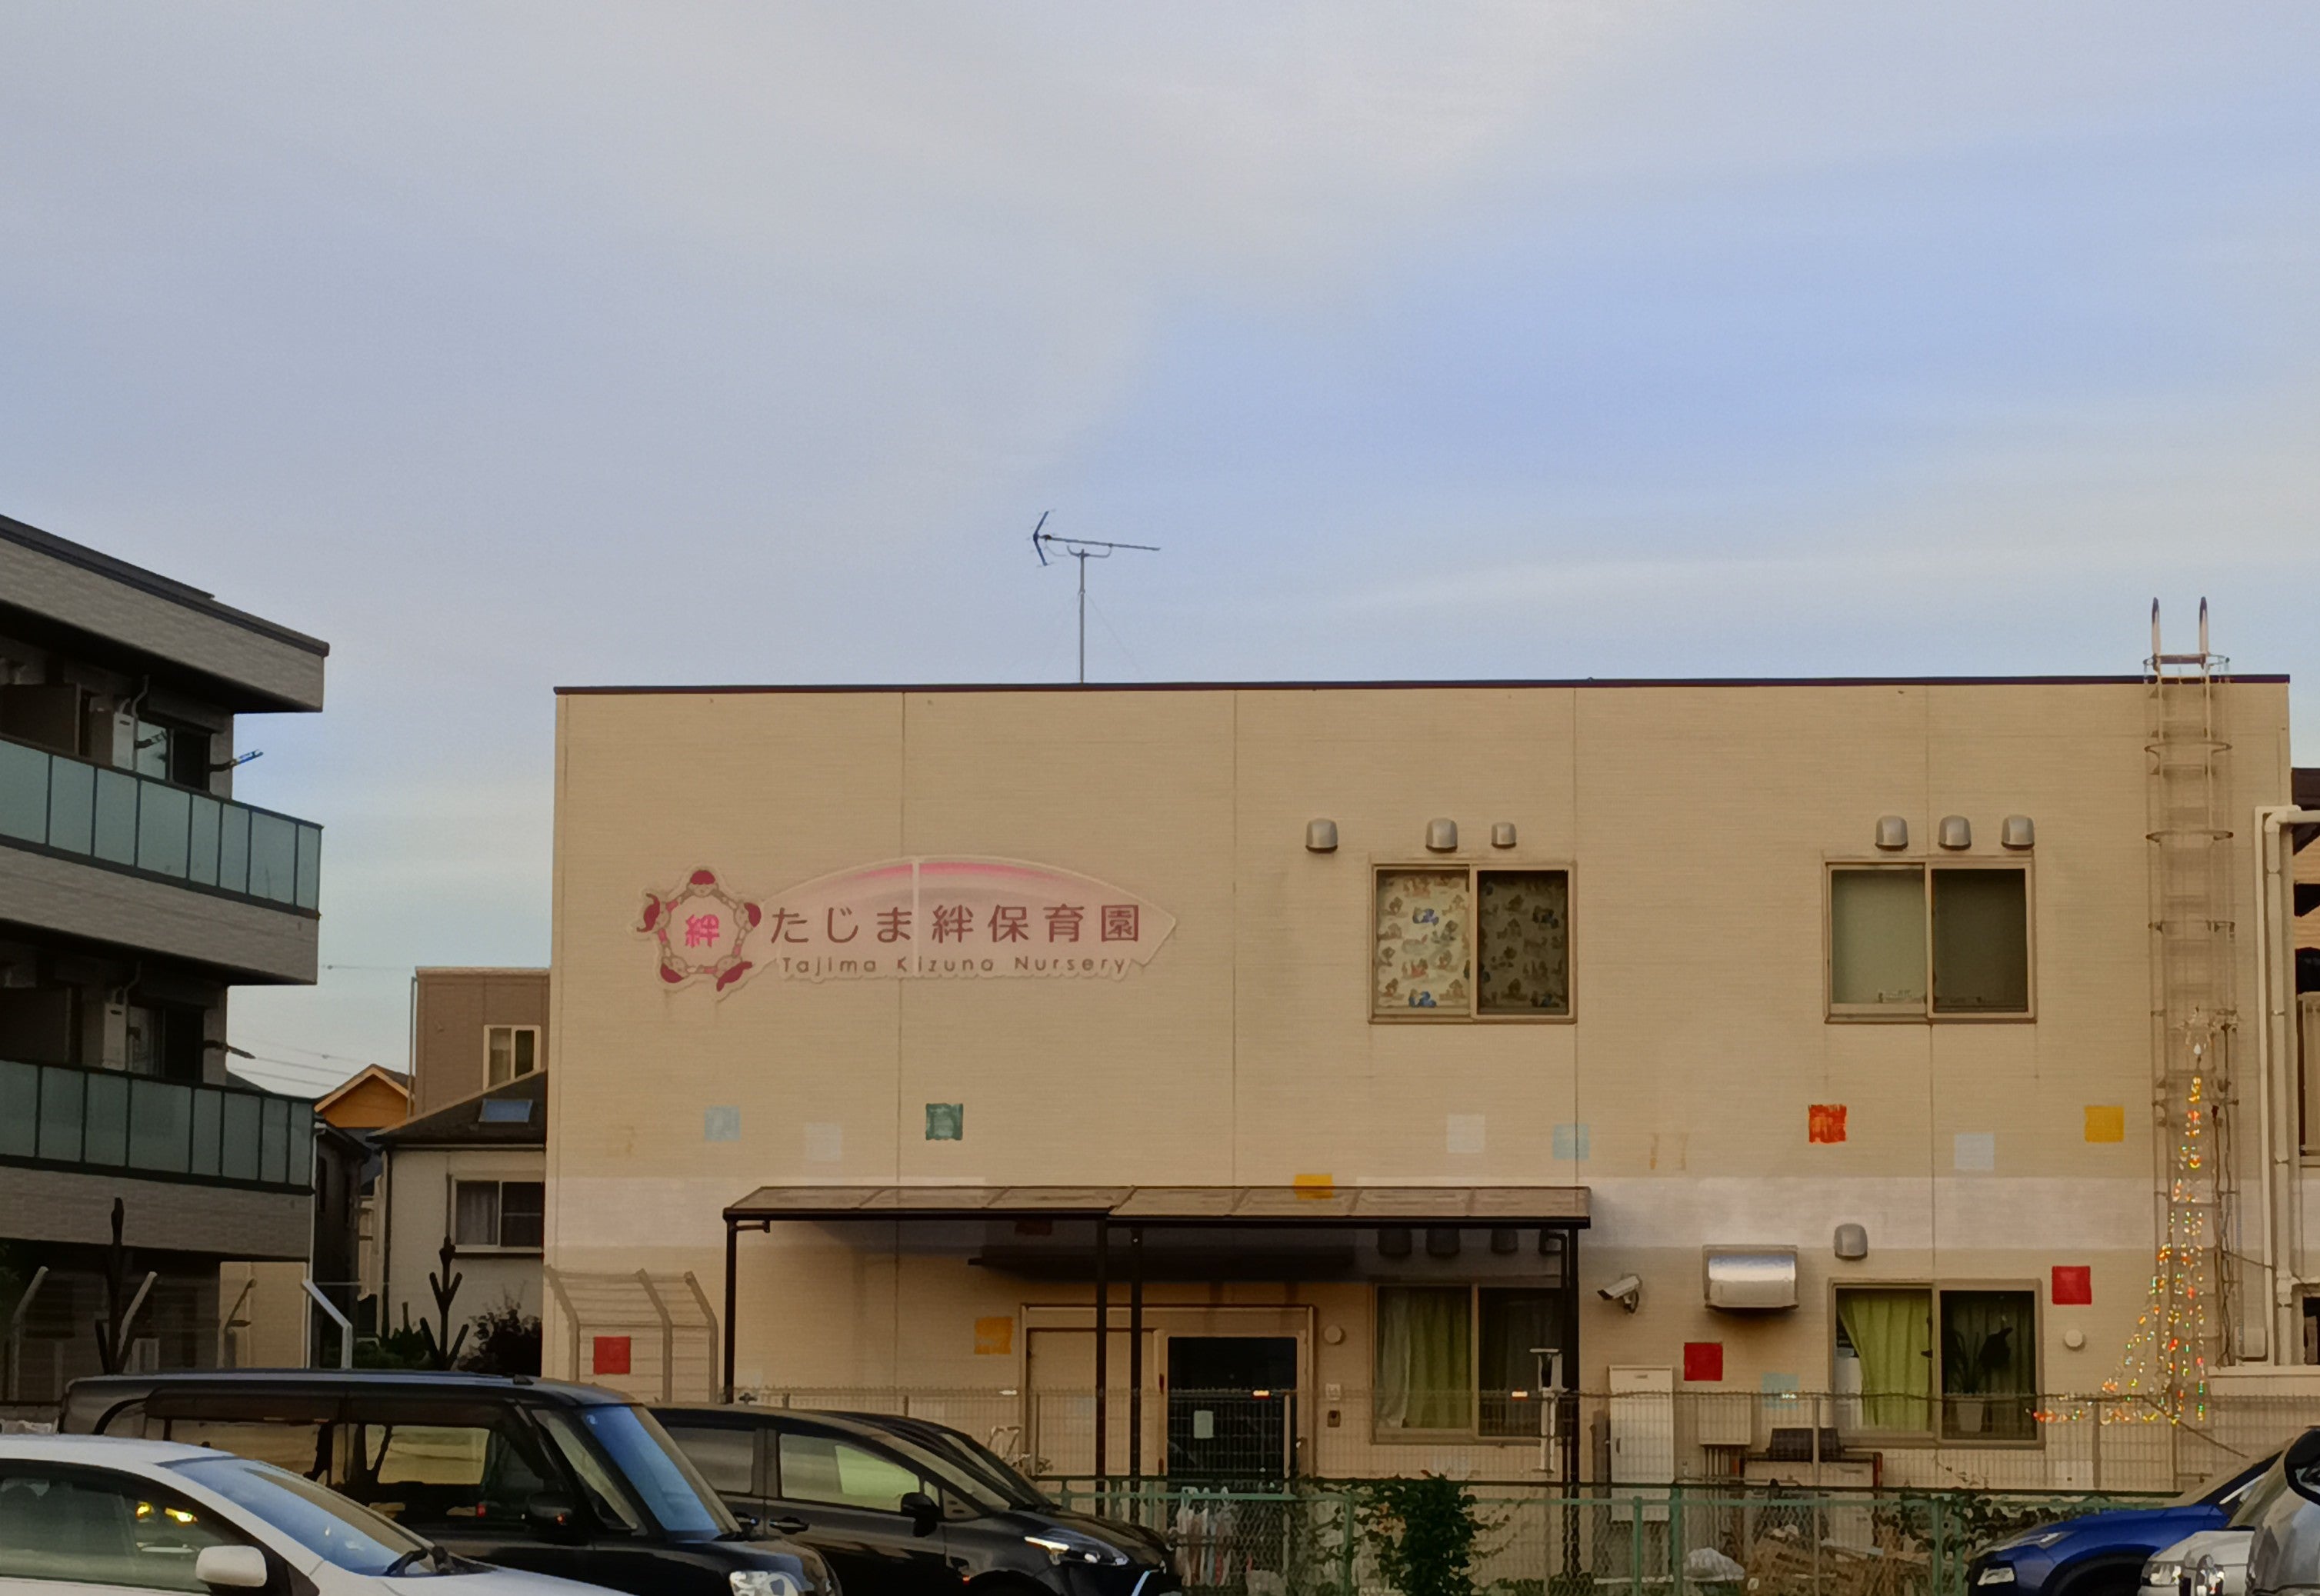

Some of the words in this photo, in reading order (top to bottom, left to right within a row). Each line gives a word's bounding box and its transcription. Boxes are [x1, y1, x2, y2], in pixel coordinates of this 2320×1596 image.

[685, 914, 720, 948] 絆
[771, 904, 1139, 944] たじま絆保育園
[782, 955, 876, 978] Tajima
[897, 955, 994, 972] Kizuna
[1015, 955, 1125, 975] Nursery
